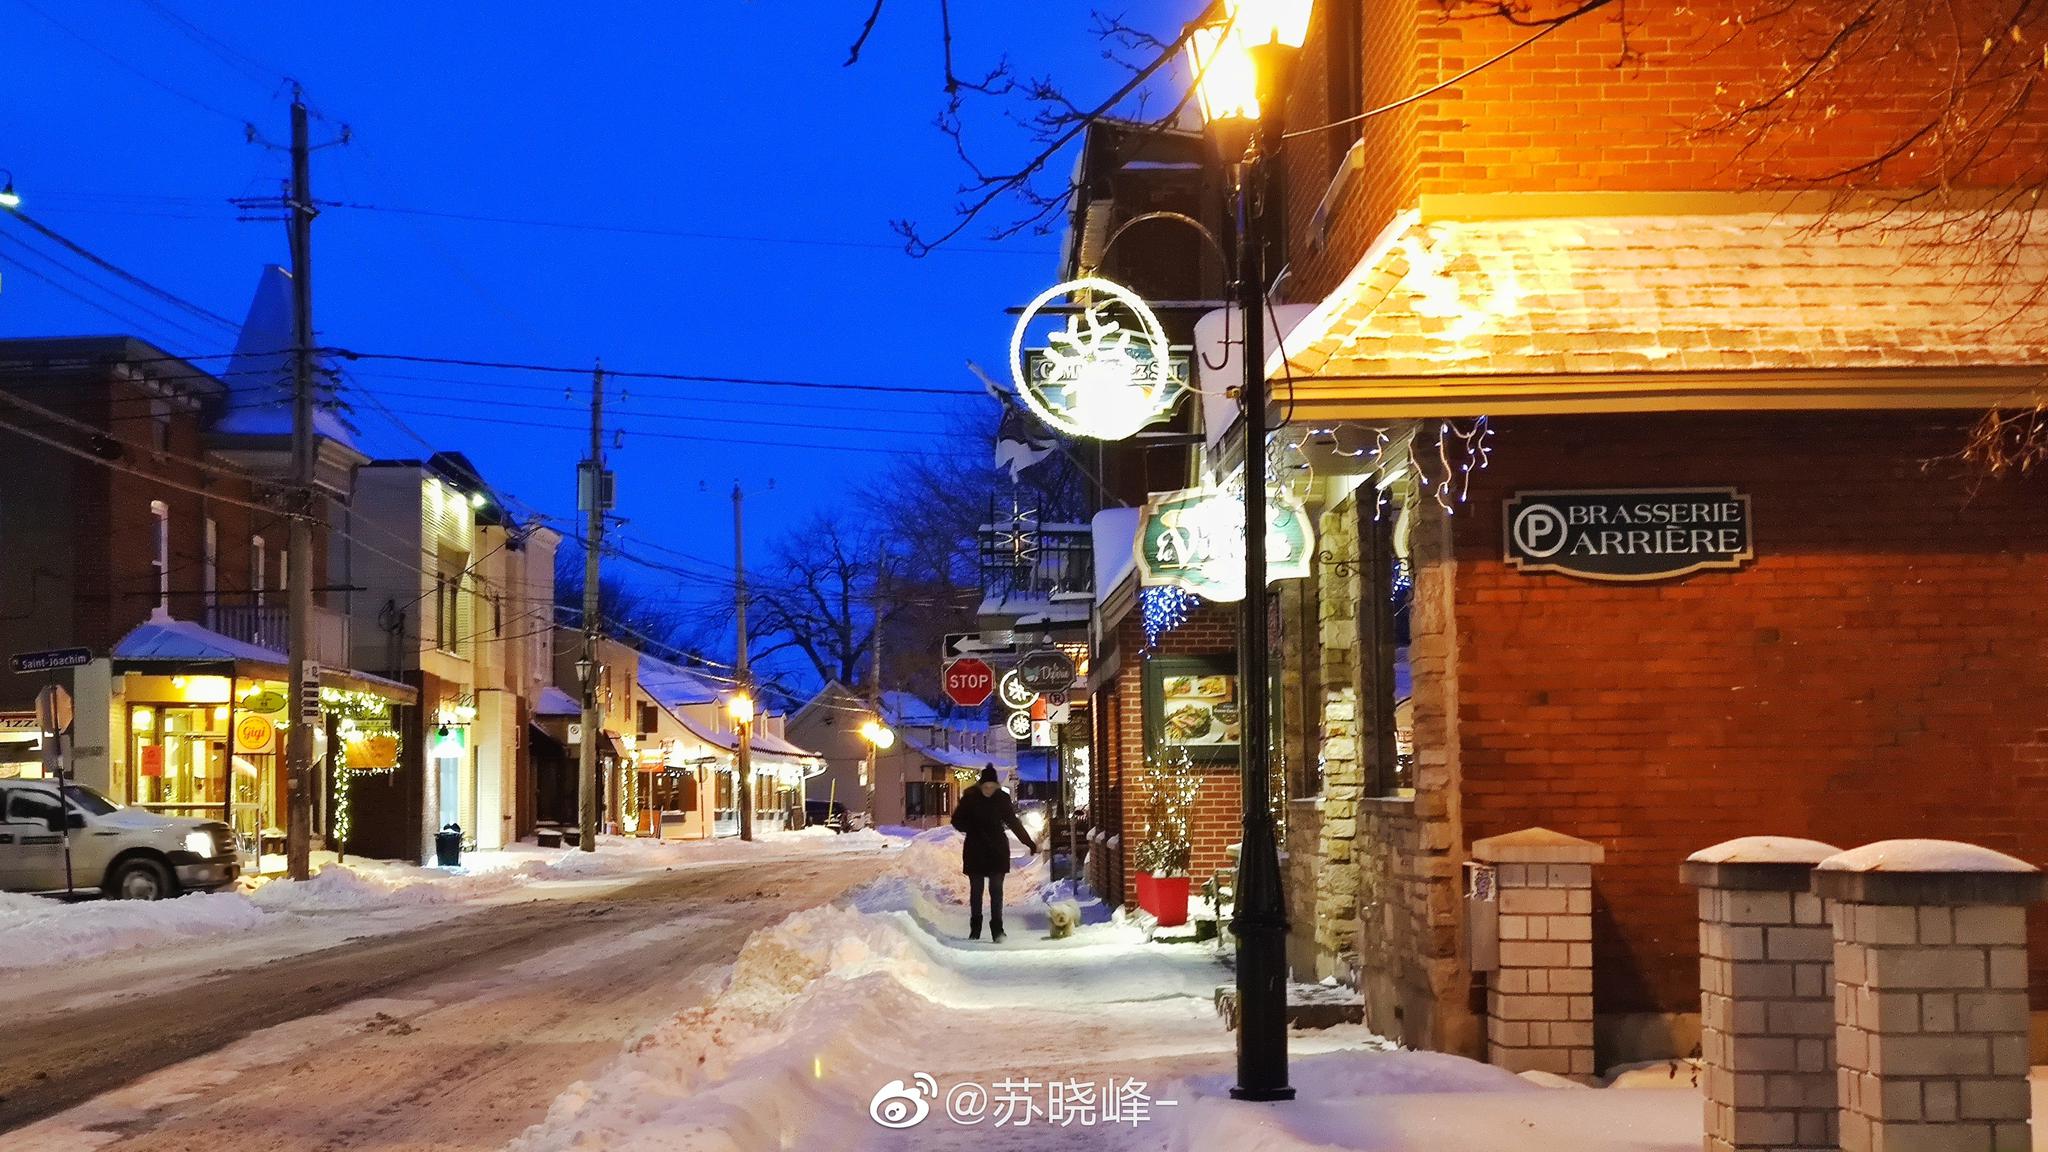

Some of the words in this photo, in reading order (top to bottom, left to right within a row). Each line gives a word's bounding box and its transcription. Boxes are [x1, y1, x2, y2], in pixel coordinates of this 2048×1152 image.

[1568, 502, 1741, 525] BRASSERIE
[1570, 525, 1742, 556] ARRIÈRE
[21, 653, 87, 670] Saint-Joachim
[950, 674, 989, 689] STOP
